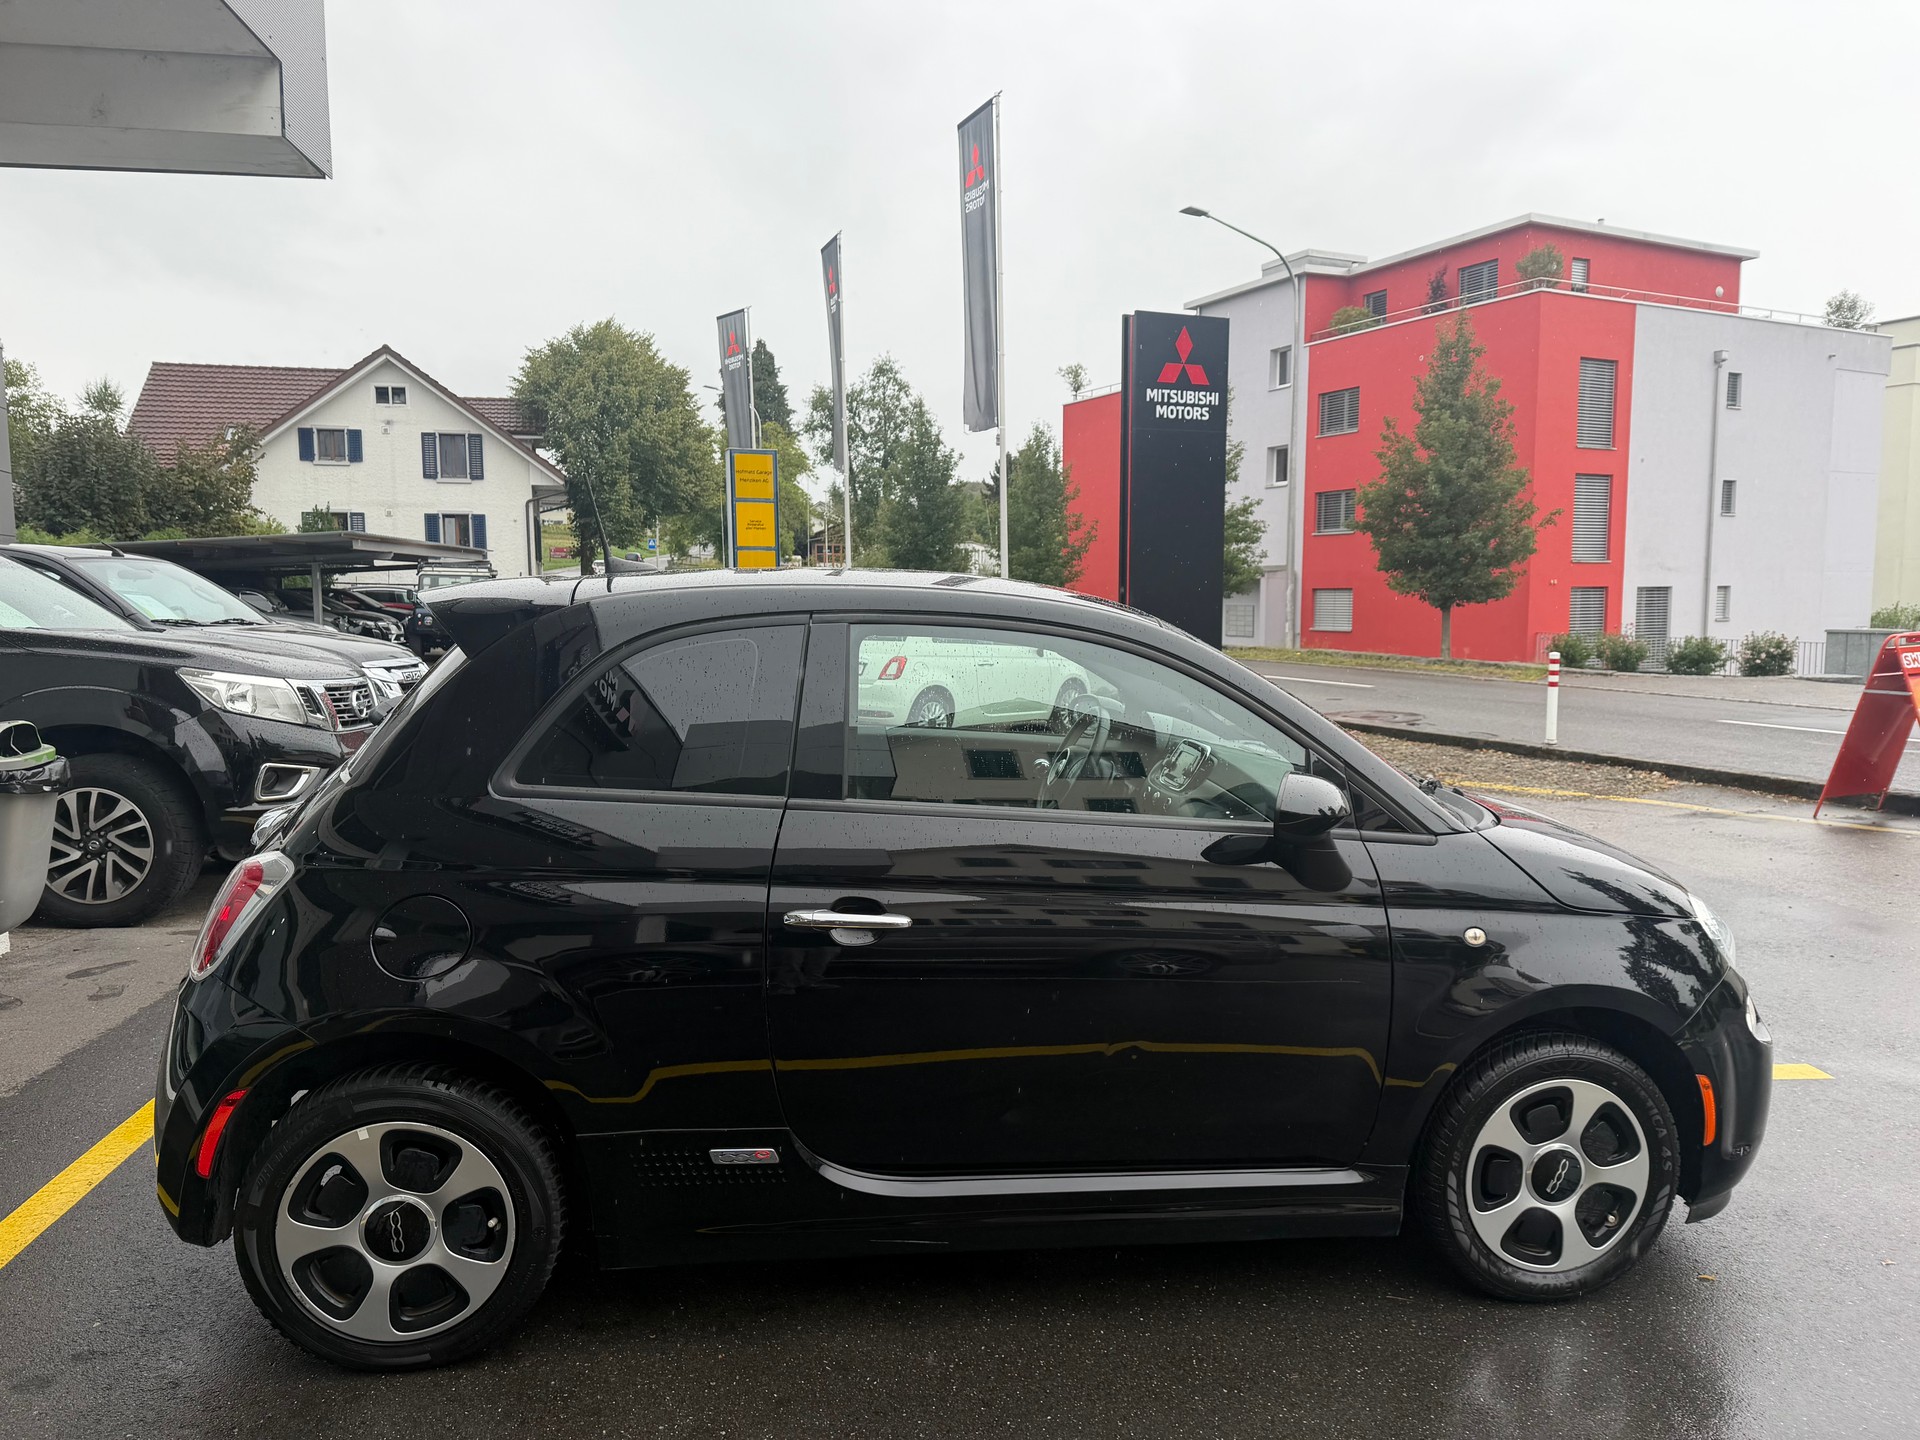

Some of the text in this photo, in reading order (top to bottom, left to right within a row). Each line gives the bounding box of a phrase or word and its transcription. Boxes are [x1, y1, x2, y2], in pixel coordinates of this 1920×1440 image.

[1145, 388, 1219, 406] MITSUBISHI
[1155, 404, 1210, 421] MOTORS
[1903, 653, 1920, 667] SW
